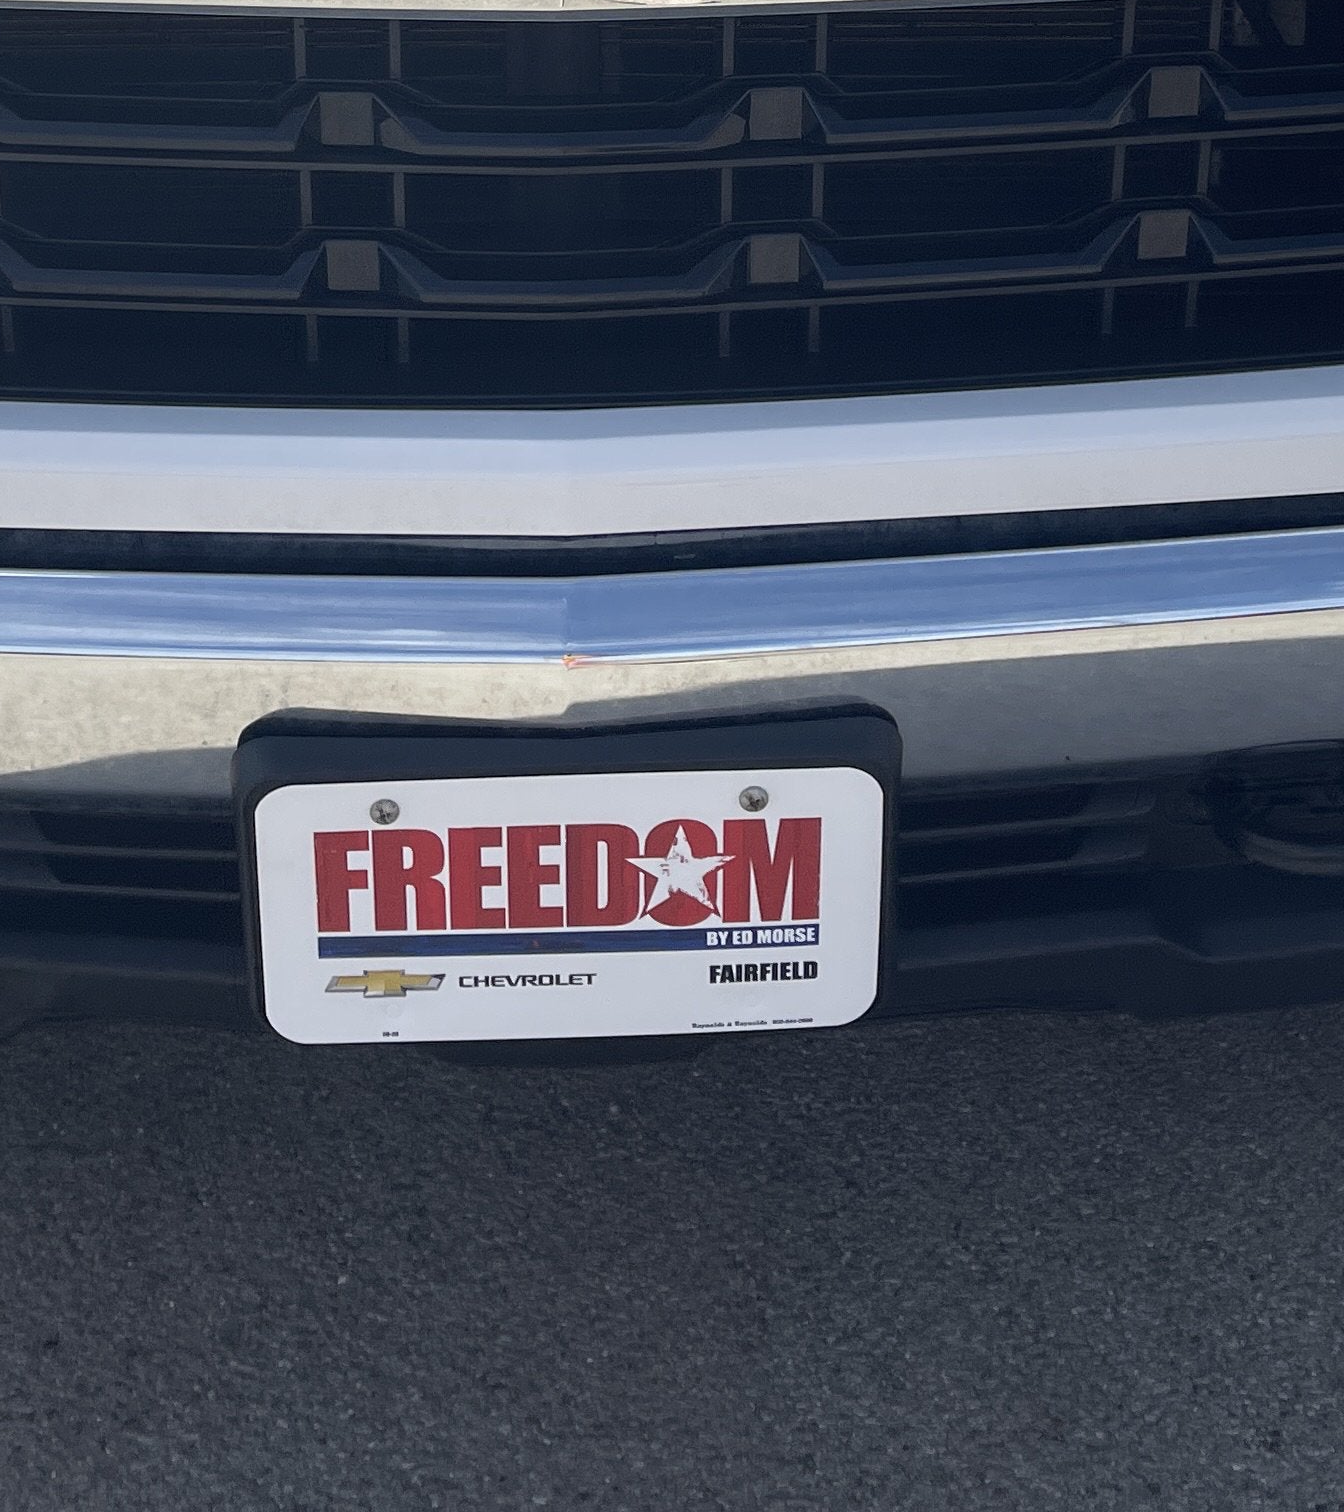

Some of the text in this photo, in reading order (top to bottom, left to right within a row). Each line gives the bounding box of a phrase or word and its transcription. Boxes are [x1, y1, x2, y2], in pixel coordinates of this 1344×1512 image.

[312, 816, 823, 933] FREEDOM
[706, 926, 816, 946] BY ED MORSE
[458, 972, 597, 989] CHEVROLET
[709, 960, 819, 984] FAIRFIELD
